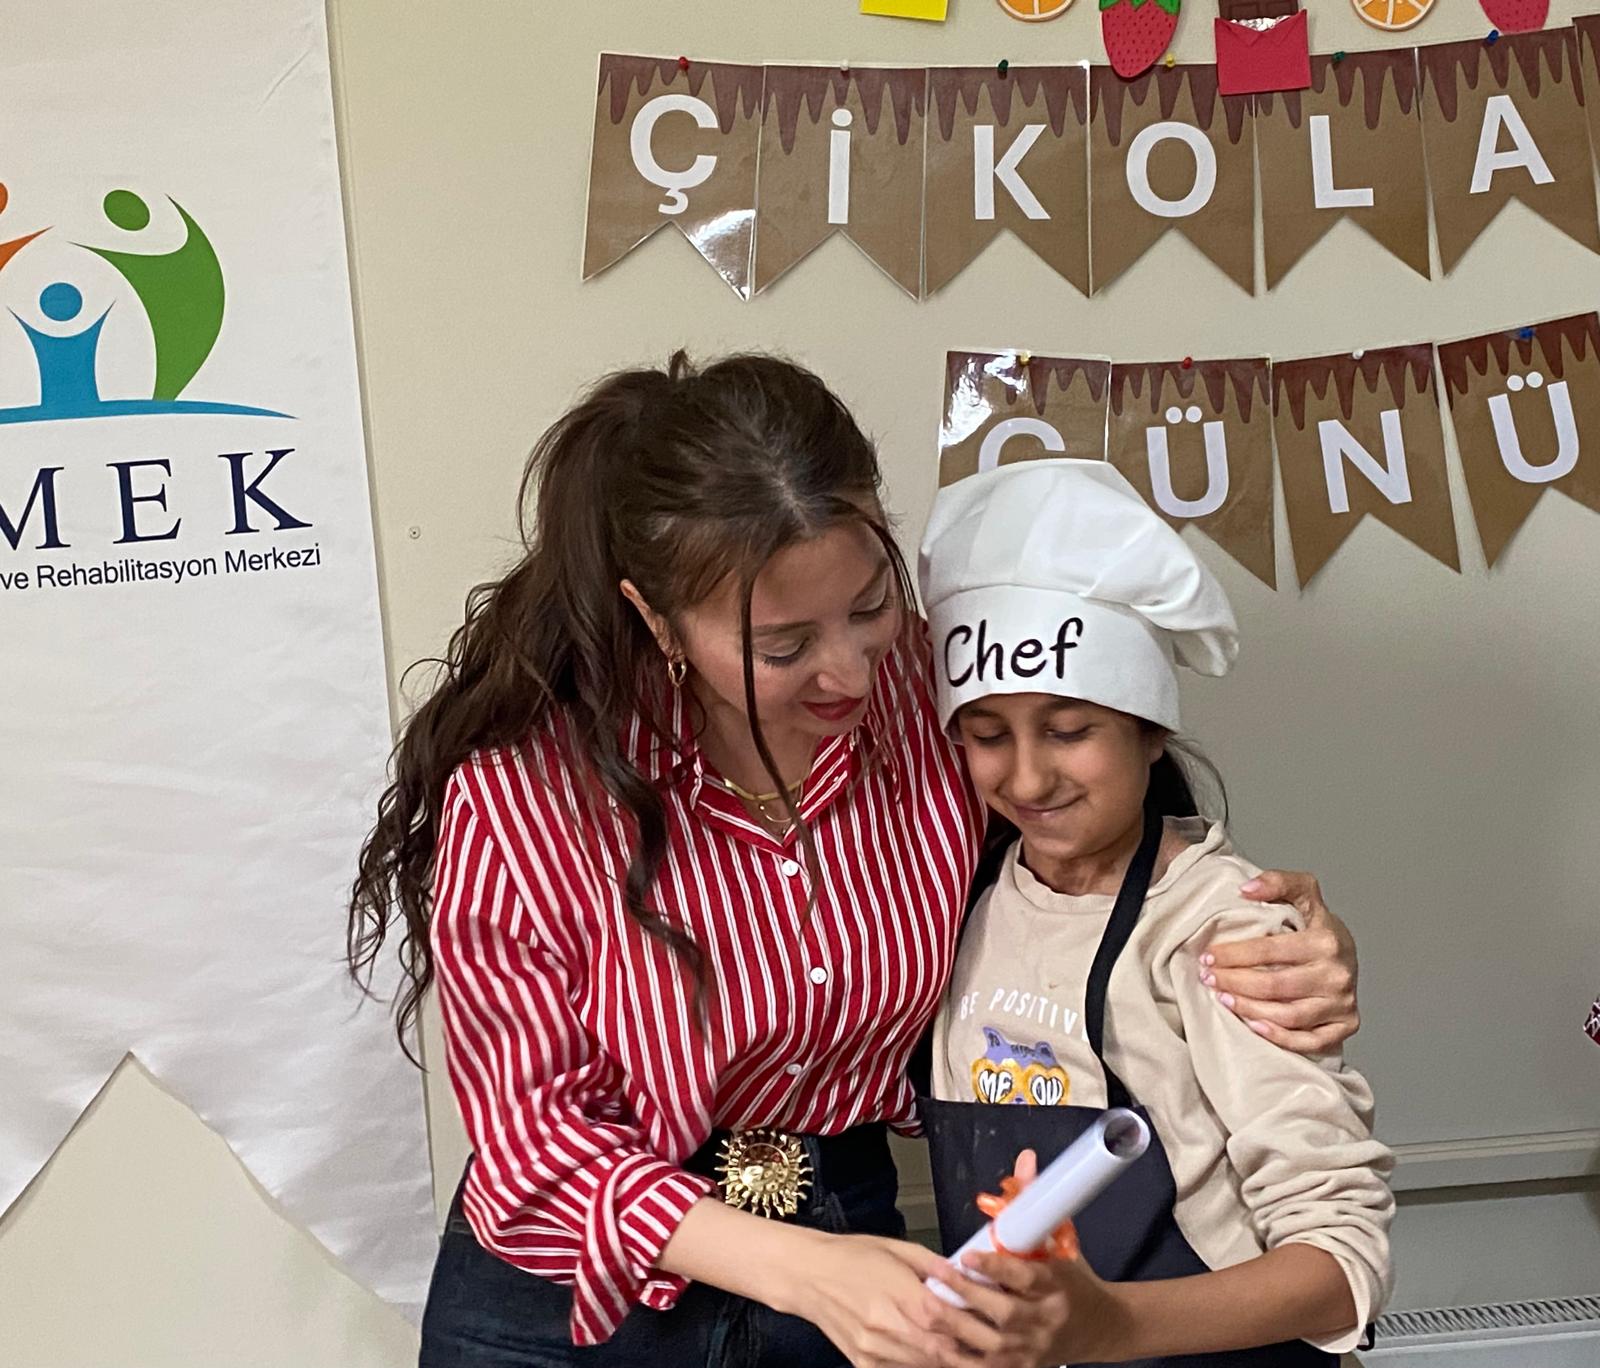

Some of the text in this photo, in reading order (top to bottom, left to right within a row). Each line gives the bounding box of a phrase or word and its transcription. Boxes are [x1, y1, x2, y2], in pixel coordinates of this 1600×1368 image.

[0, 543, 321, 590] ve Rehabilitasyon Merkezi
[944, 617, 1084, 687] Chef
[960, 987, 1090, 1041] BE POSITIV
